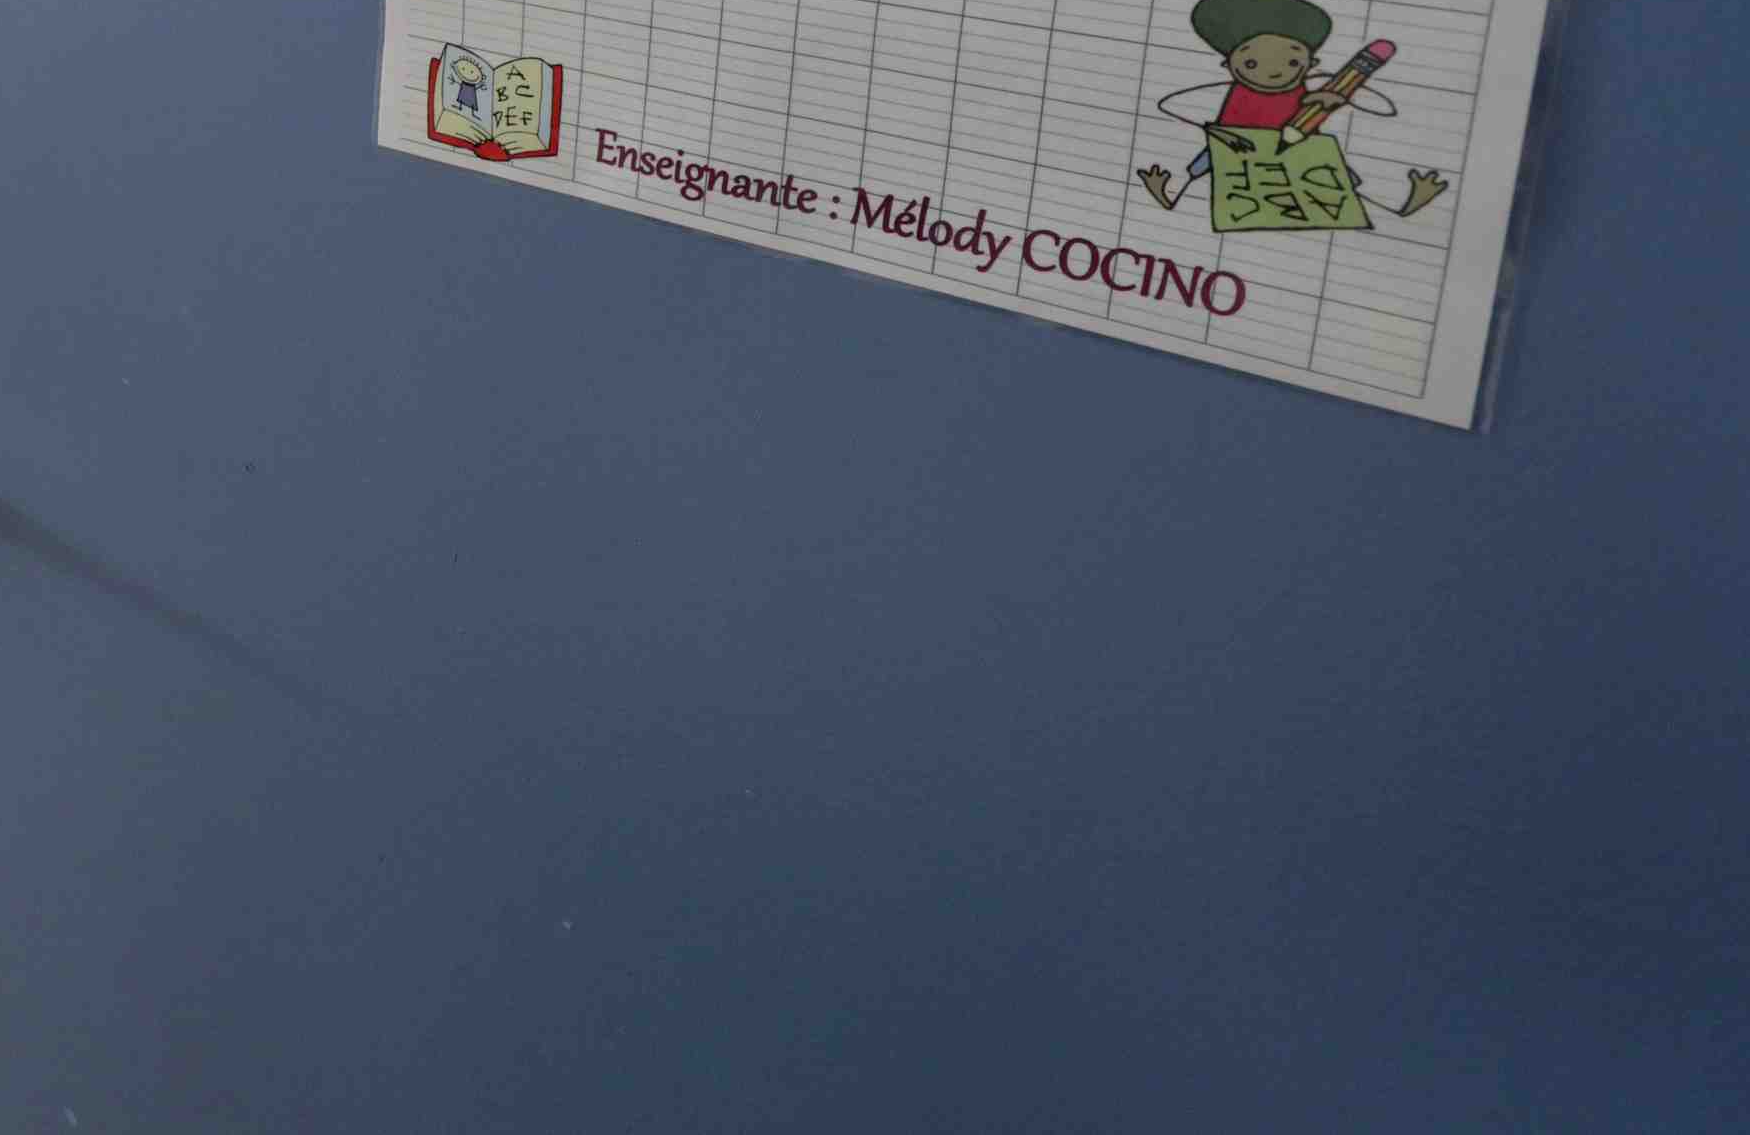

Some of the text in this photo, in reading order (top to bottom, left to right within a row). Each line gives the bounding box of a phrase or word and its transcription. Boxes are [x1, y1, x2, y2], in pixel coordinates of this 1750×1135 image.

[595, 128, 818, 215] Enseignante
[850, 187, 1012, 273] Mélody
[1022, 228, 1247, 316] COCINO
